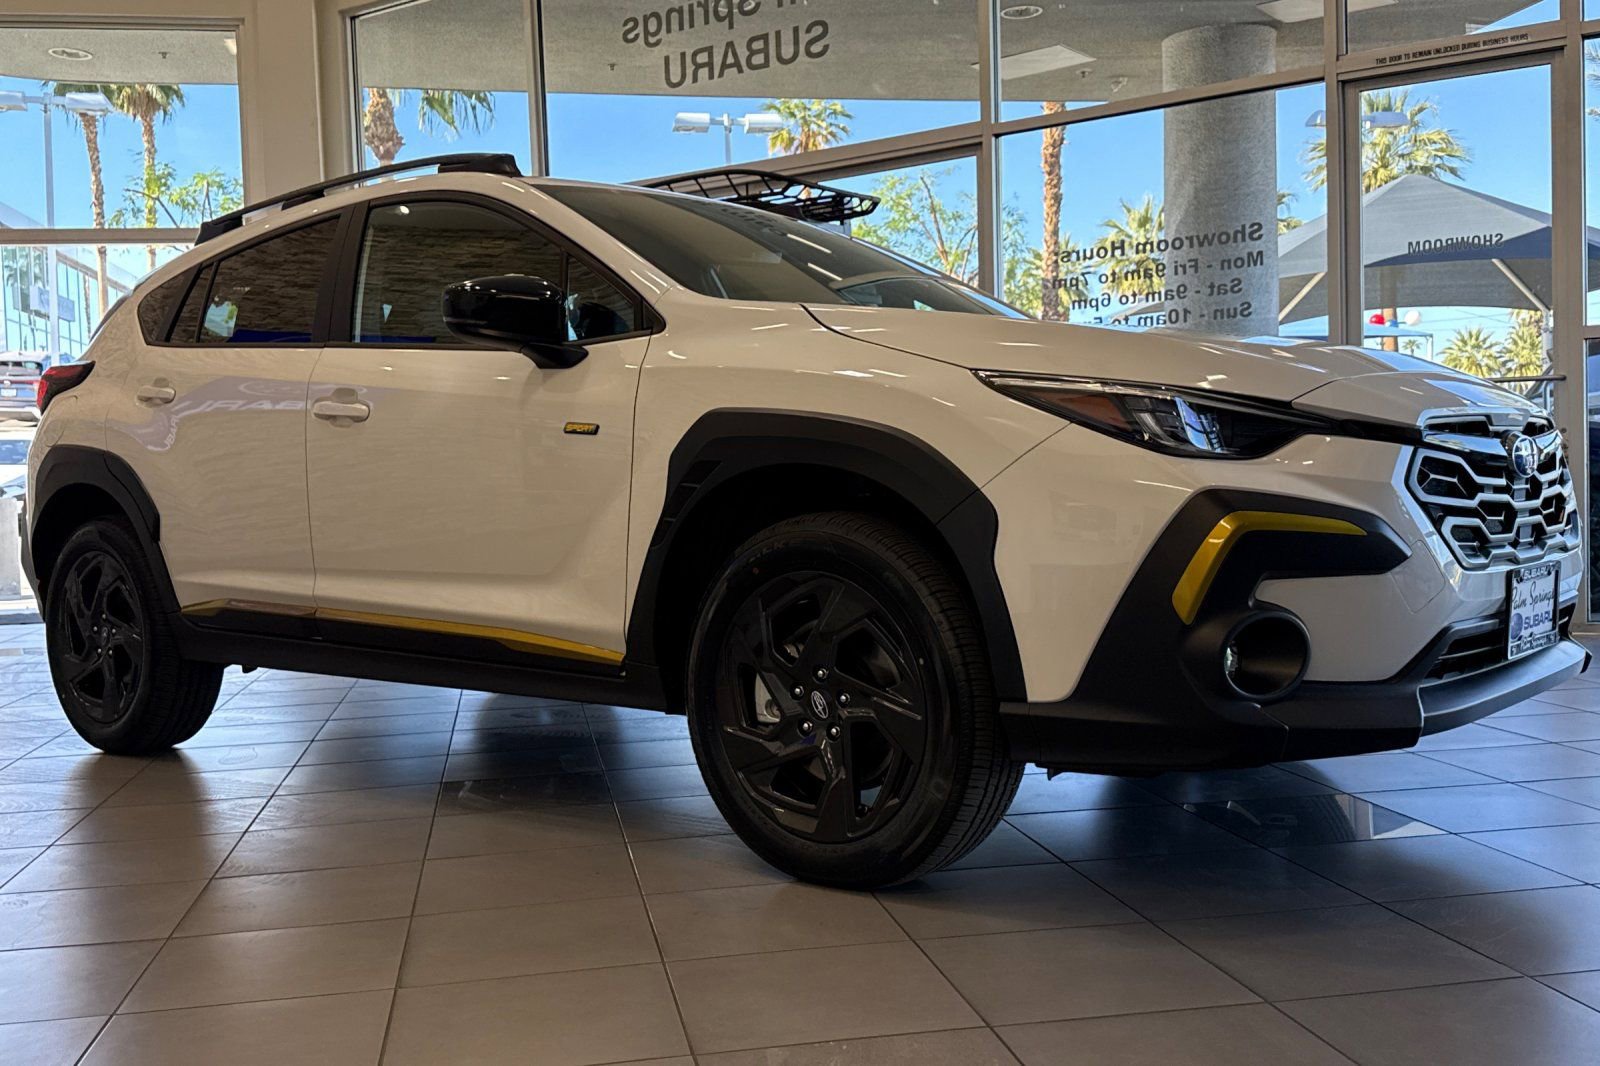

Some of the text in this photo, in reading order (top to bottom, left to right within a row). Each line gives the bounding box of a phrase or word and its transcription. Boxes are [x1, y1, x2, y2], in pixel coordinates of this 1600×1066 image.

[1376, 33, 1529, 65] THIS DOOR TO REMAIN UNLOCKED DURING BUSINESS HOURS
[1529, 581, 1555, 612] Spring
